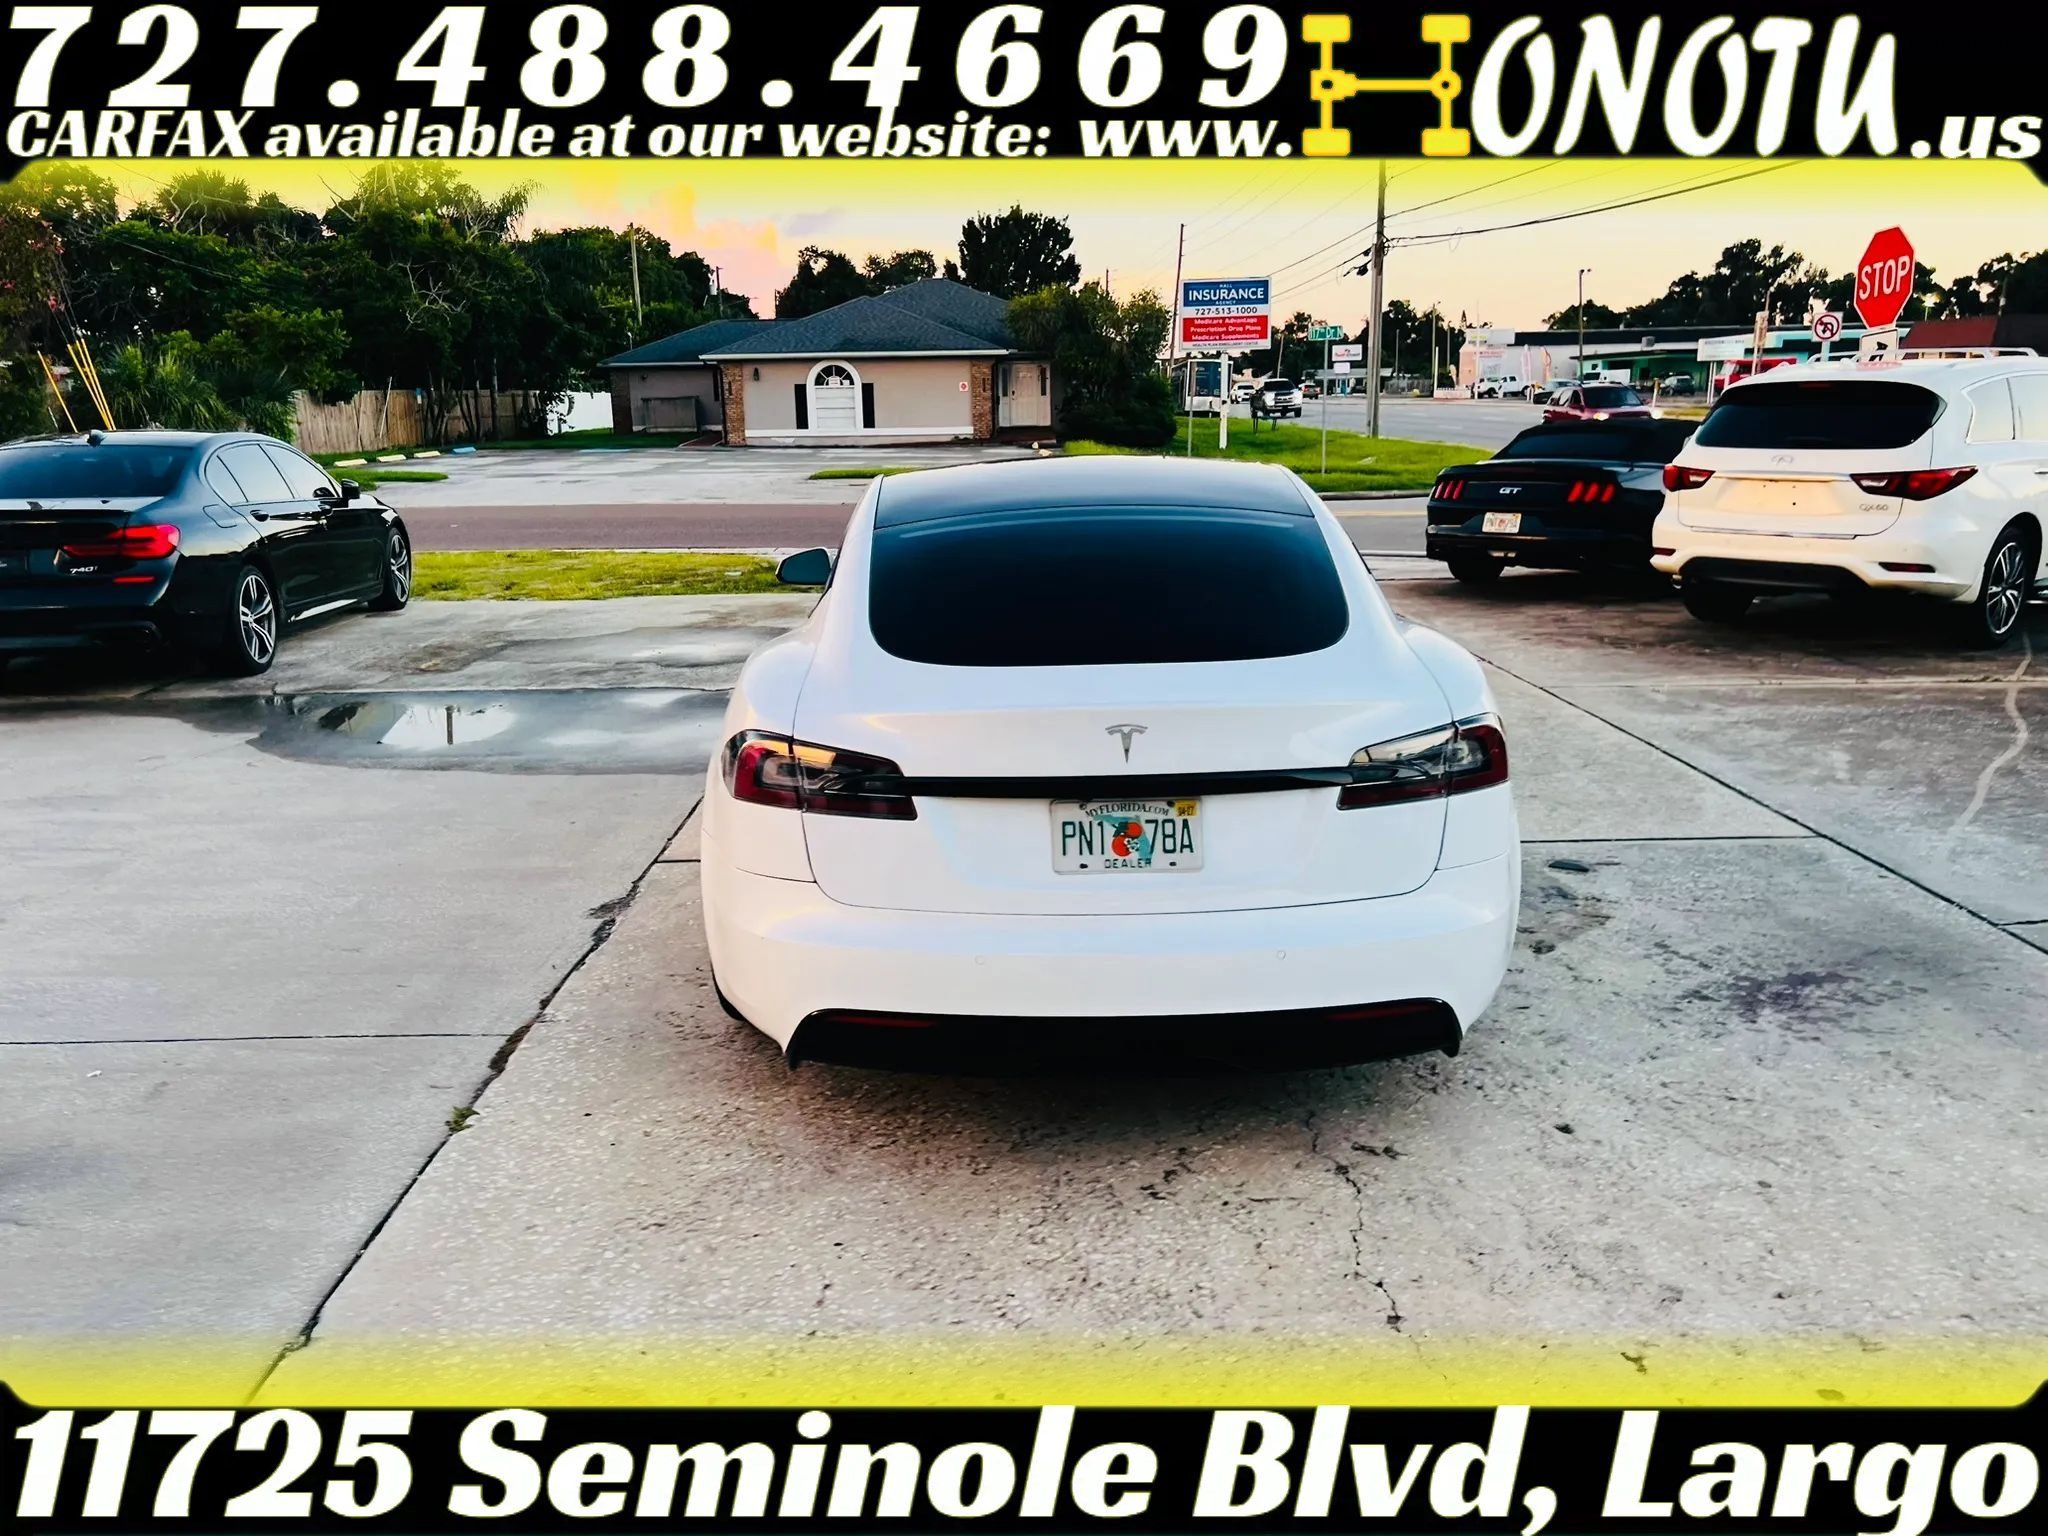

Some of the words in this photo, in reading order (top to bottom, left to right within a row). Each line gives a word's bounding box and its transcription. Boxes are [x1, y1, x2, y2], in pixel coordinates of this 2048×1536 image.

[1858, 255, 1911, 301] STOP
[1188, 288, 1265, 301] INSURANCE
[1194, 306, 1258, 315] 727-513-1000
[1104, 858, 1153, 869] DEALER
